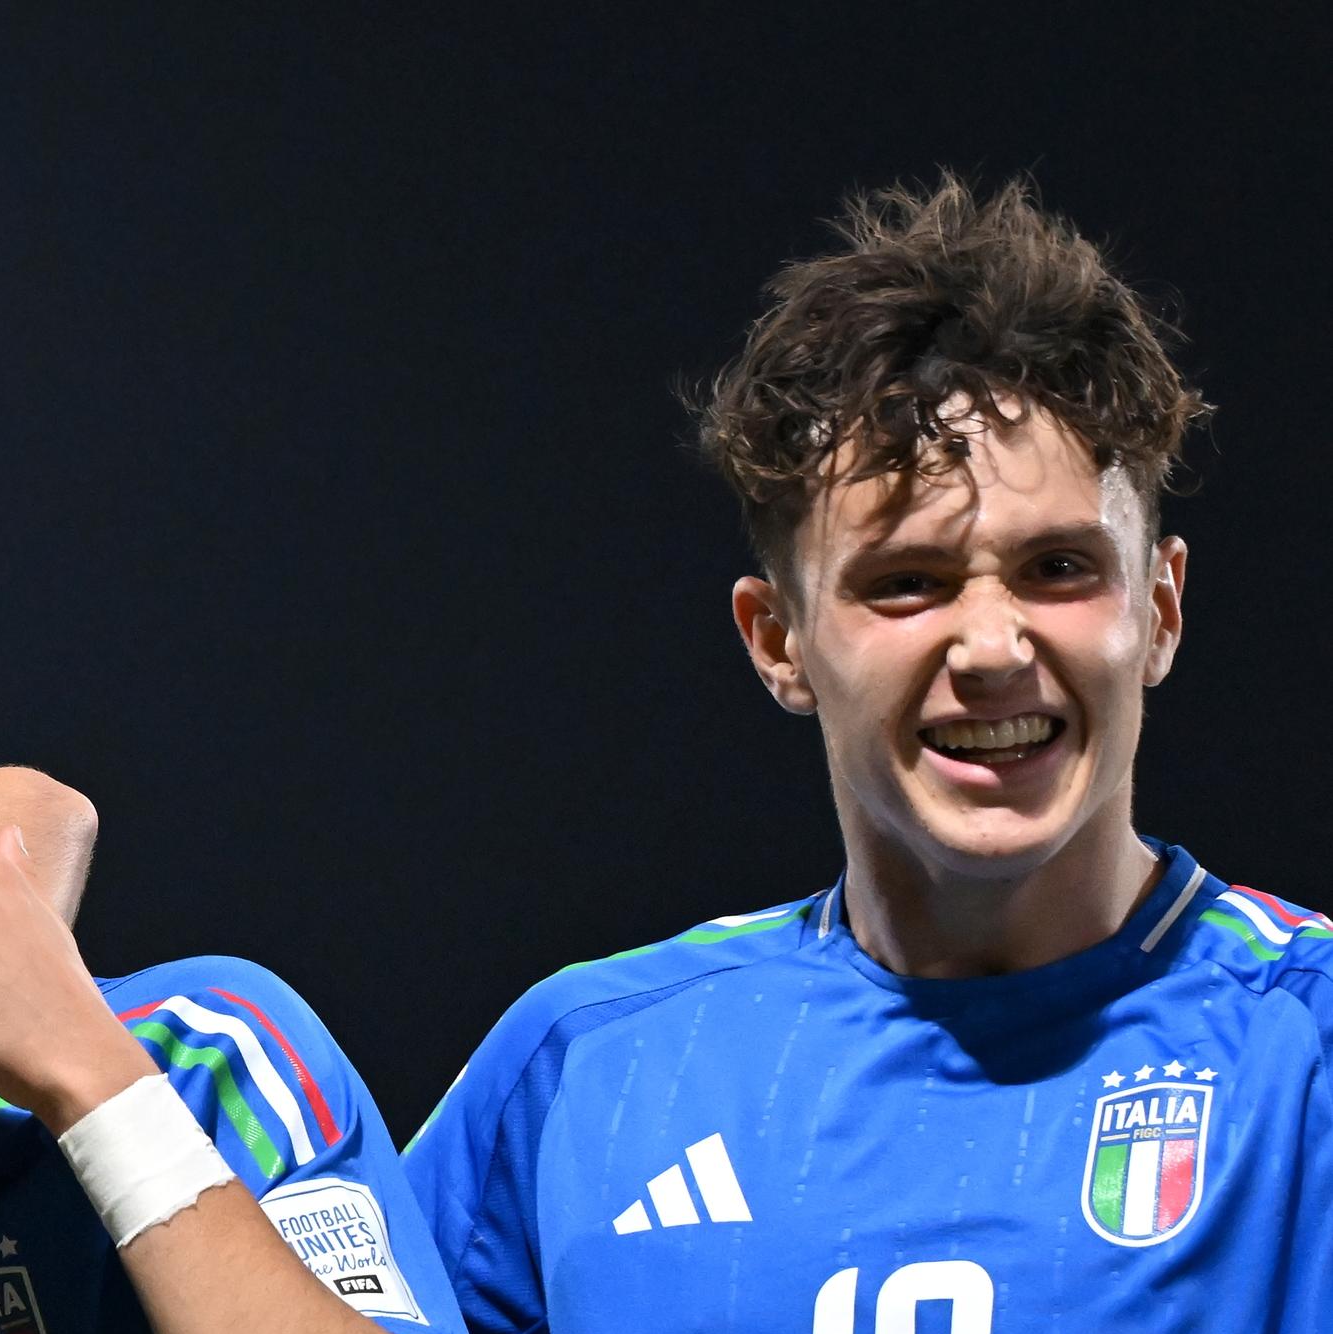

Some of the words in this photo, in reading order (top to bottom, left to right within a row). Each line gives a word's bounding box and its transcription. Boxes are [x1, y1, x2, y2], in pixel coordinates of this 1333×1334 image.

[1102, 1096, 1198, 1132] ITALIA
[1133, 1127, 1162, 1140] FIGC
[278, 1203, 365, 1238] FOOTBALL
[288, 1221, 377, 1261] UNITES
[307, 1261, 334, 1276] he
[340, 1278, 379, 1292] FIFA
